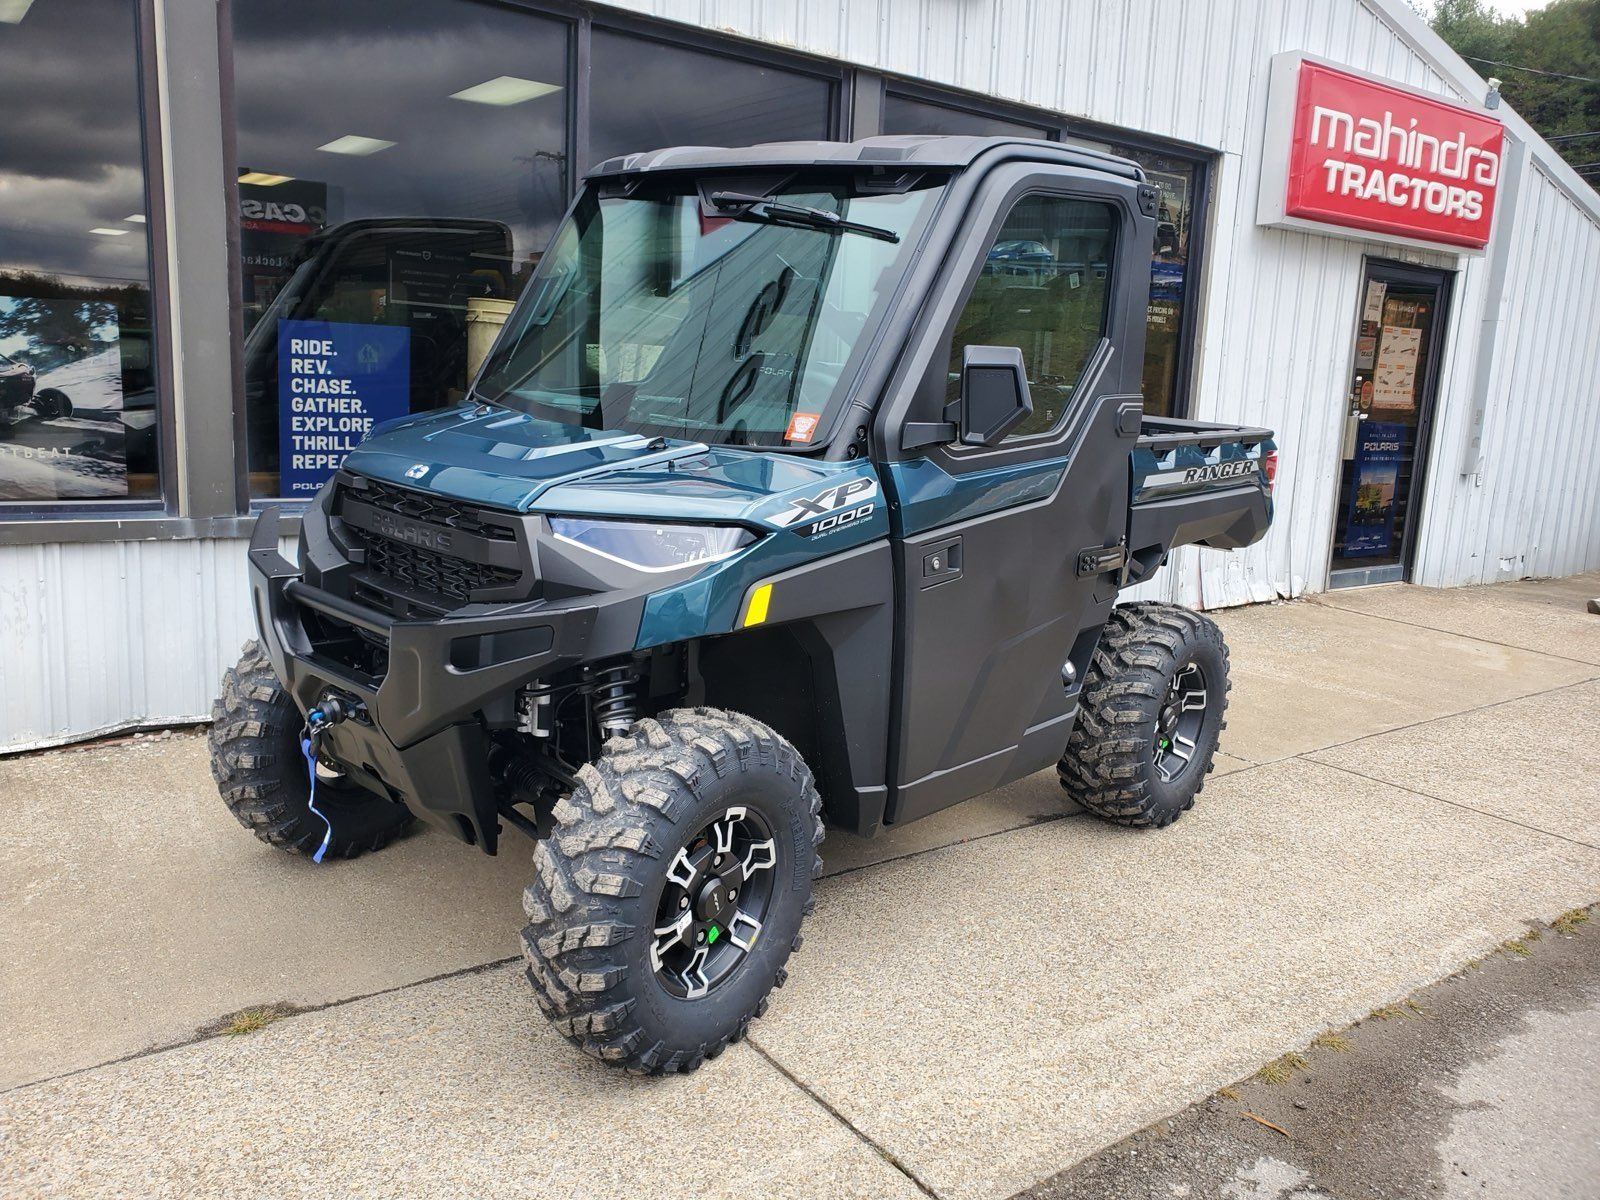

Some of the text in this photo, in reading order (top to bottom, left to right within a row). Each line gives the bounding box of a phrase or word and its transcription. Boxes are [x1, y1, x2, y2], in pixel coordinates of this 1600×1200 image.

[1310, 105, 1499, 186] mahindra
[1323, 158, 1483, 221] TRACTORS
[290, 338, 338, 356] RIDE.
[291, 358, 332, 375] REV.
[291, 378, 357, 395] CHASE.
[291, 397, 368, 414] GATHER.
[292, 416, 374, 432] EXPLORE
[292, 435, 356, 451] THRILL
[1363, 442, 1400, 451] POLARIS
[1183, 460, 1255, 484] RANGER
[785, 477, 873, 526] XP
[811, 502, 875, 535] 1000
[371, 511, 452, 550] POLARIS
